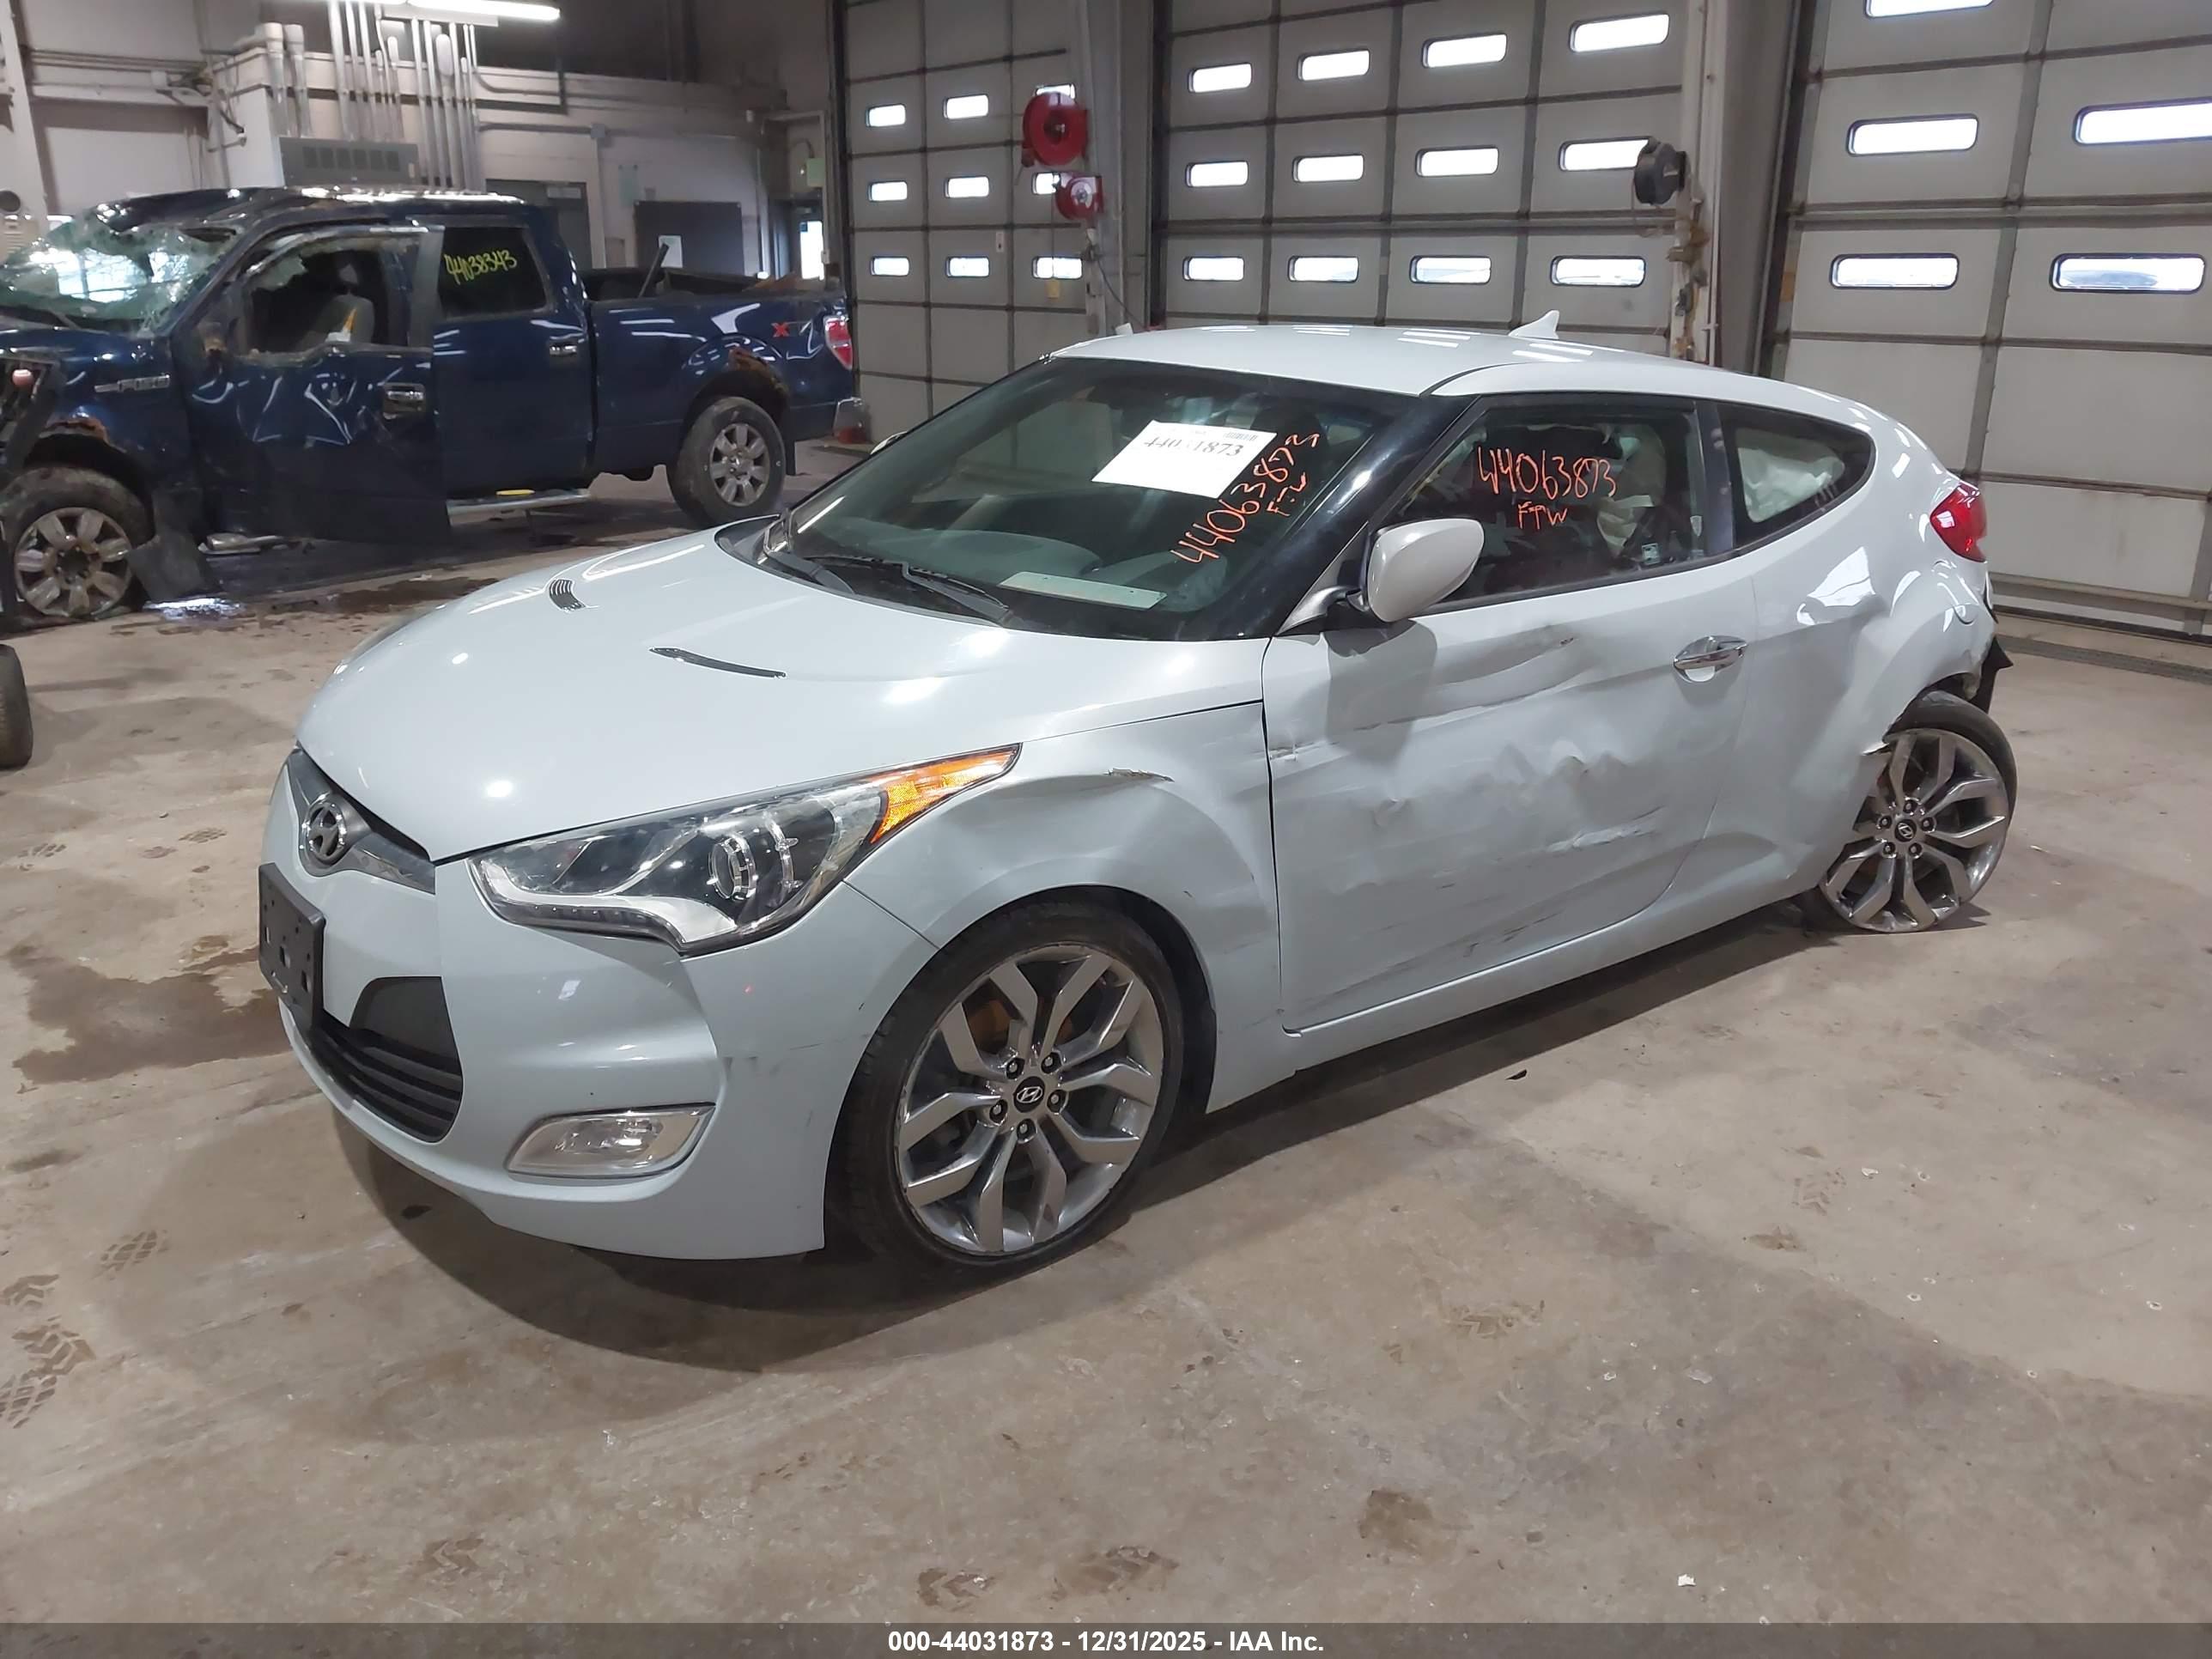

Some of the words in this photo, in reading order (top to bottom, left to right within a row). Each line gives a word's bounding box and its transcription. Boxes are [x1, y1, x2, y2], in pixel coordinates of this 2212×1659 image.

[1143, 436, 1245, 457] 4401873
[1478, 446, 1617, 500] 44063873
[1170, 432, 1321, 563] 44063873
[1517, 501, 1568, 530] FTW
